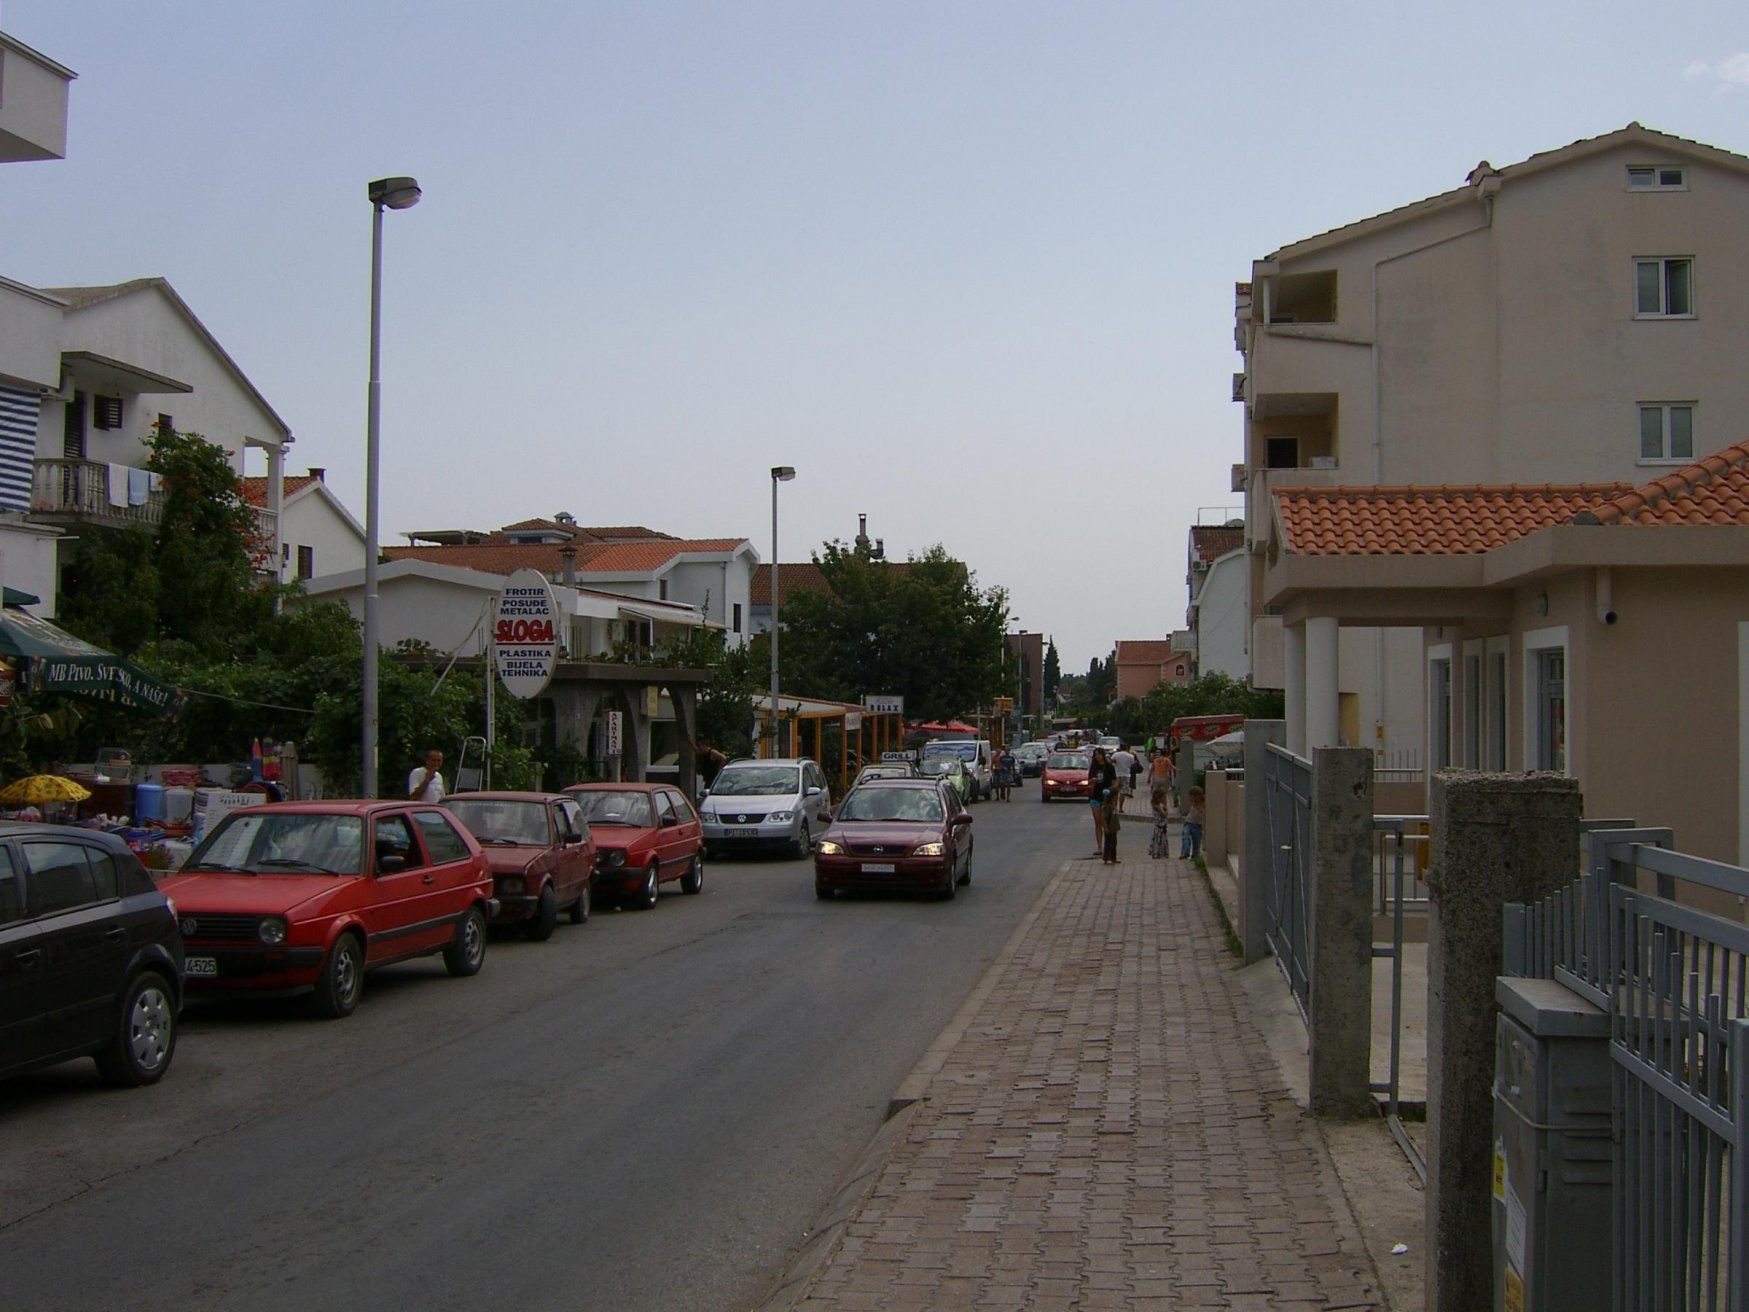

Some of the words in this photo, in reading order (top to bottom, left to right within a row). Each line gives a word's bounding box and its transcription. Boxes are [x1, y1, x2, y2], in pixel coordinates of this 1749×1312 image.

[505, 588, 544, 596] FROTIR
[502, 599, 547, 607] POSUDE
[500, 607, 549, 615] METALAC
[496, 619, 554, 642] SLOGA
[500, 649, 552, 657] PLASTIKA
[506, 661, 543, 669] BIJELA
[48, 663, 67, 682] MB
[501, 669, 548, 677] TEHNIKA
[883, 752, 911, 760] GRILL
[184, 959, 217, 973] 4-525
